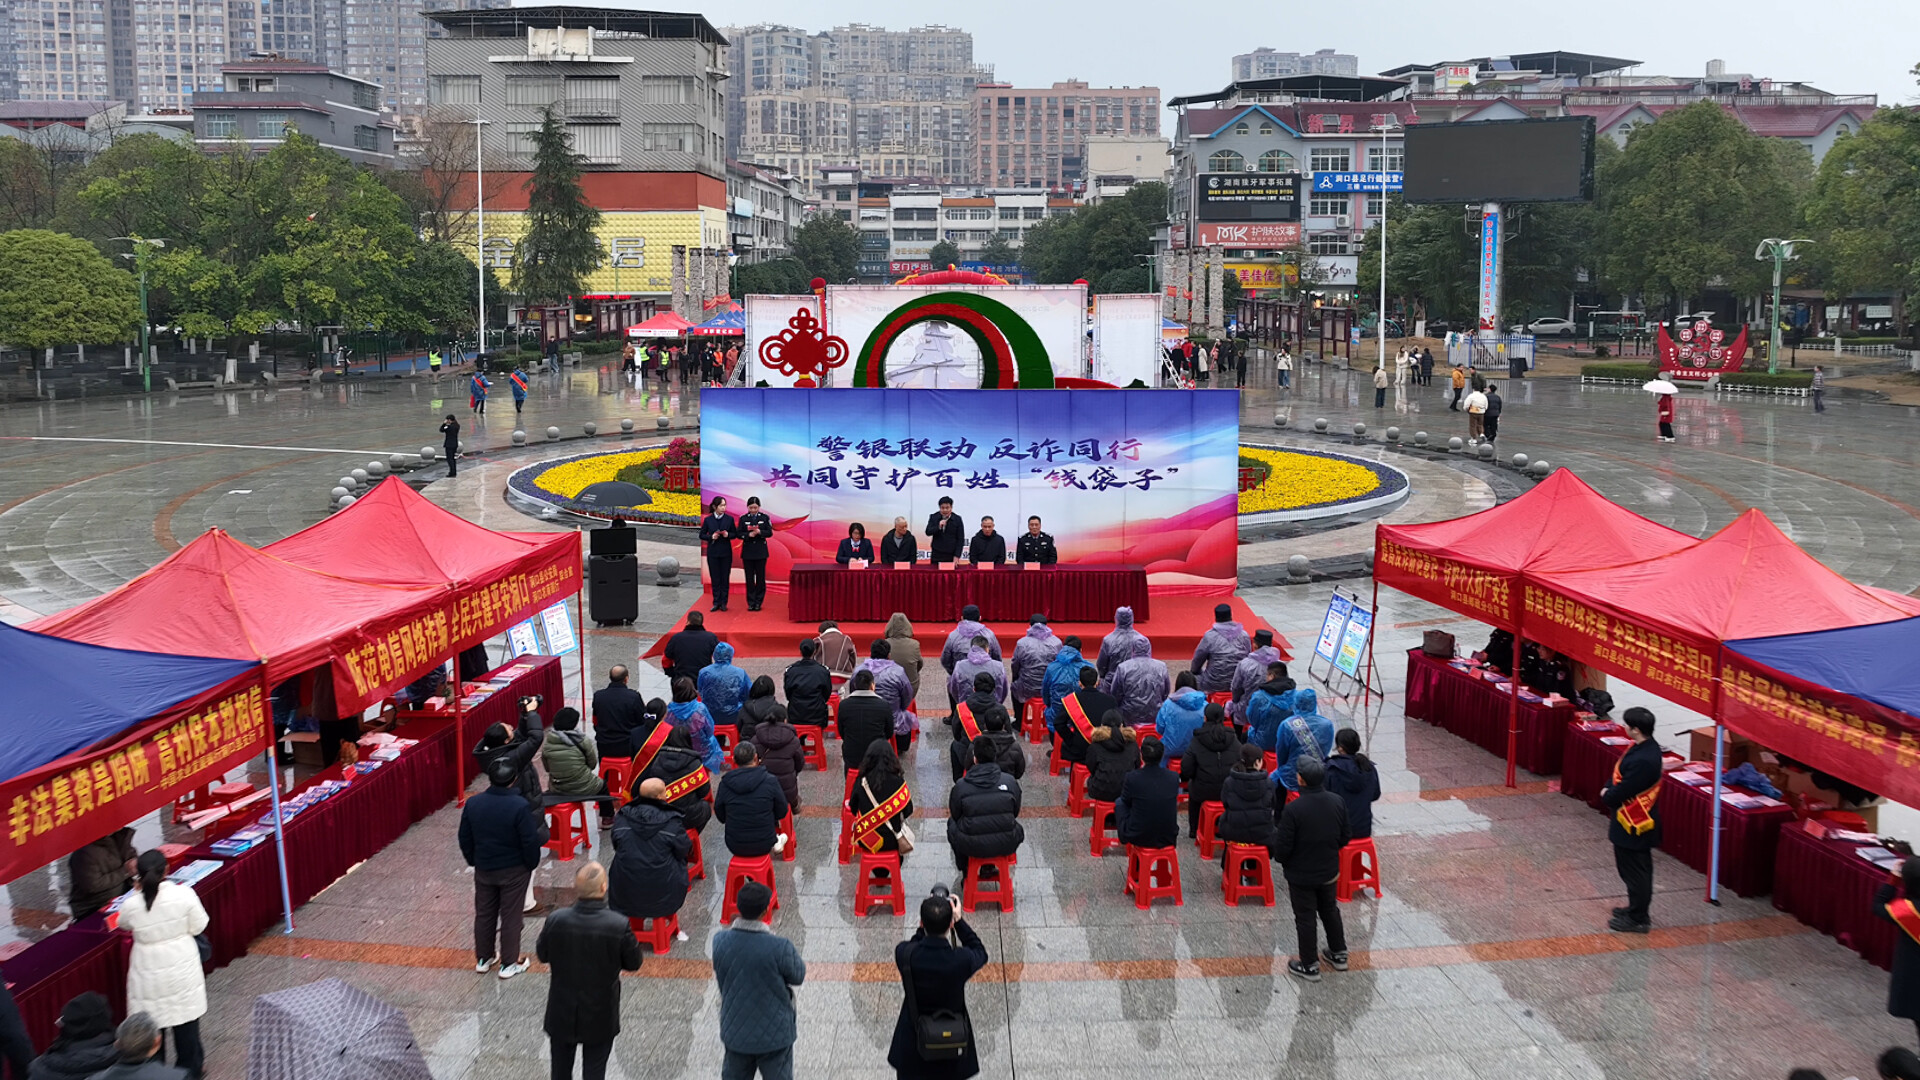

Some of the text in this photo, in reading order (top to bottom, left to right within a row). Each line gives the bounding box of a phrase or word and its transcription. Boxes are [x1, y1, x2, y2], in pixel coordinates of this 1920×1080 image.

[816, 437, 1143, 463] 警银联动 反诈同行
[344, 573, 531, 697] 防范电信网络诈骗 全民共建平安洞口
[1593, 643, 1641, 673] 洞口县公安局
[8, 742, 151, 846] 非法集资是陷阱
